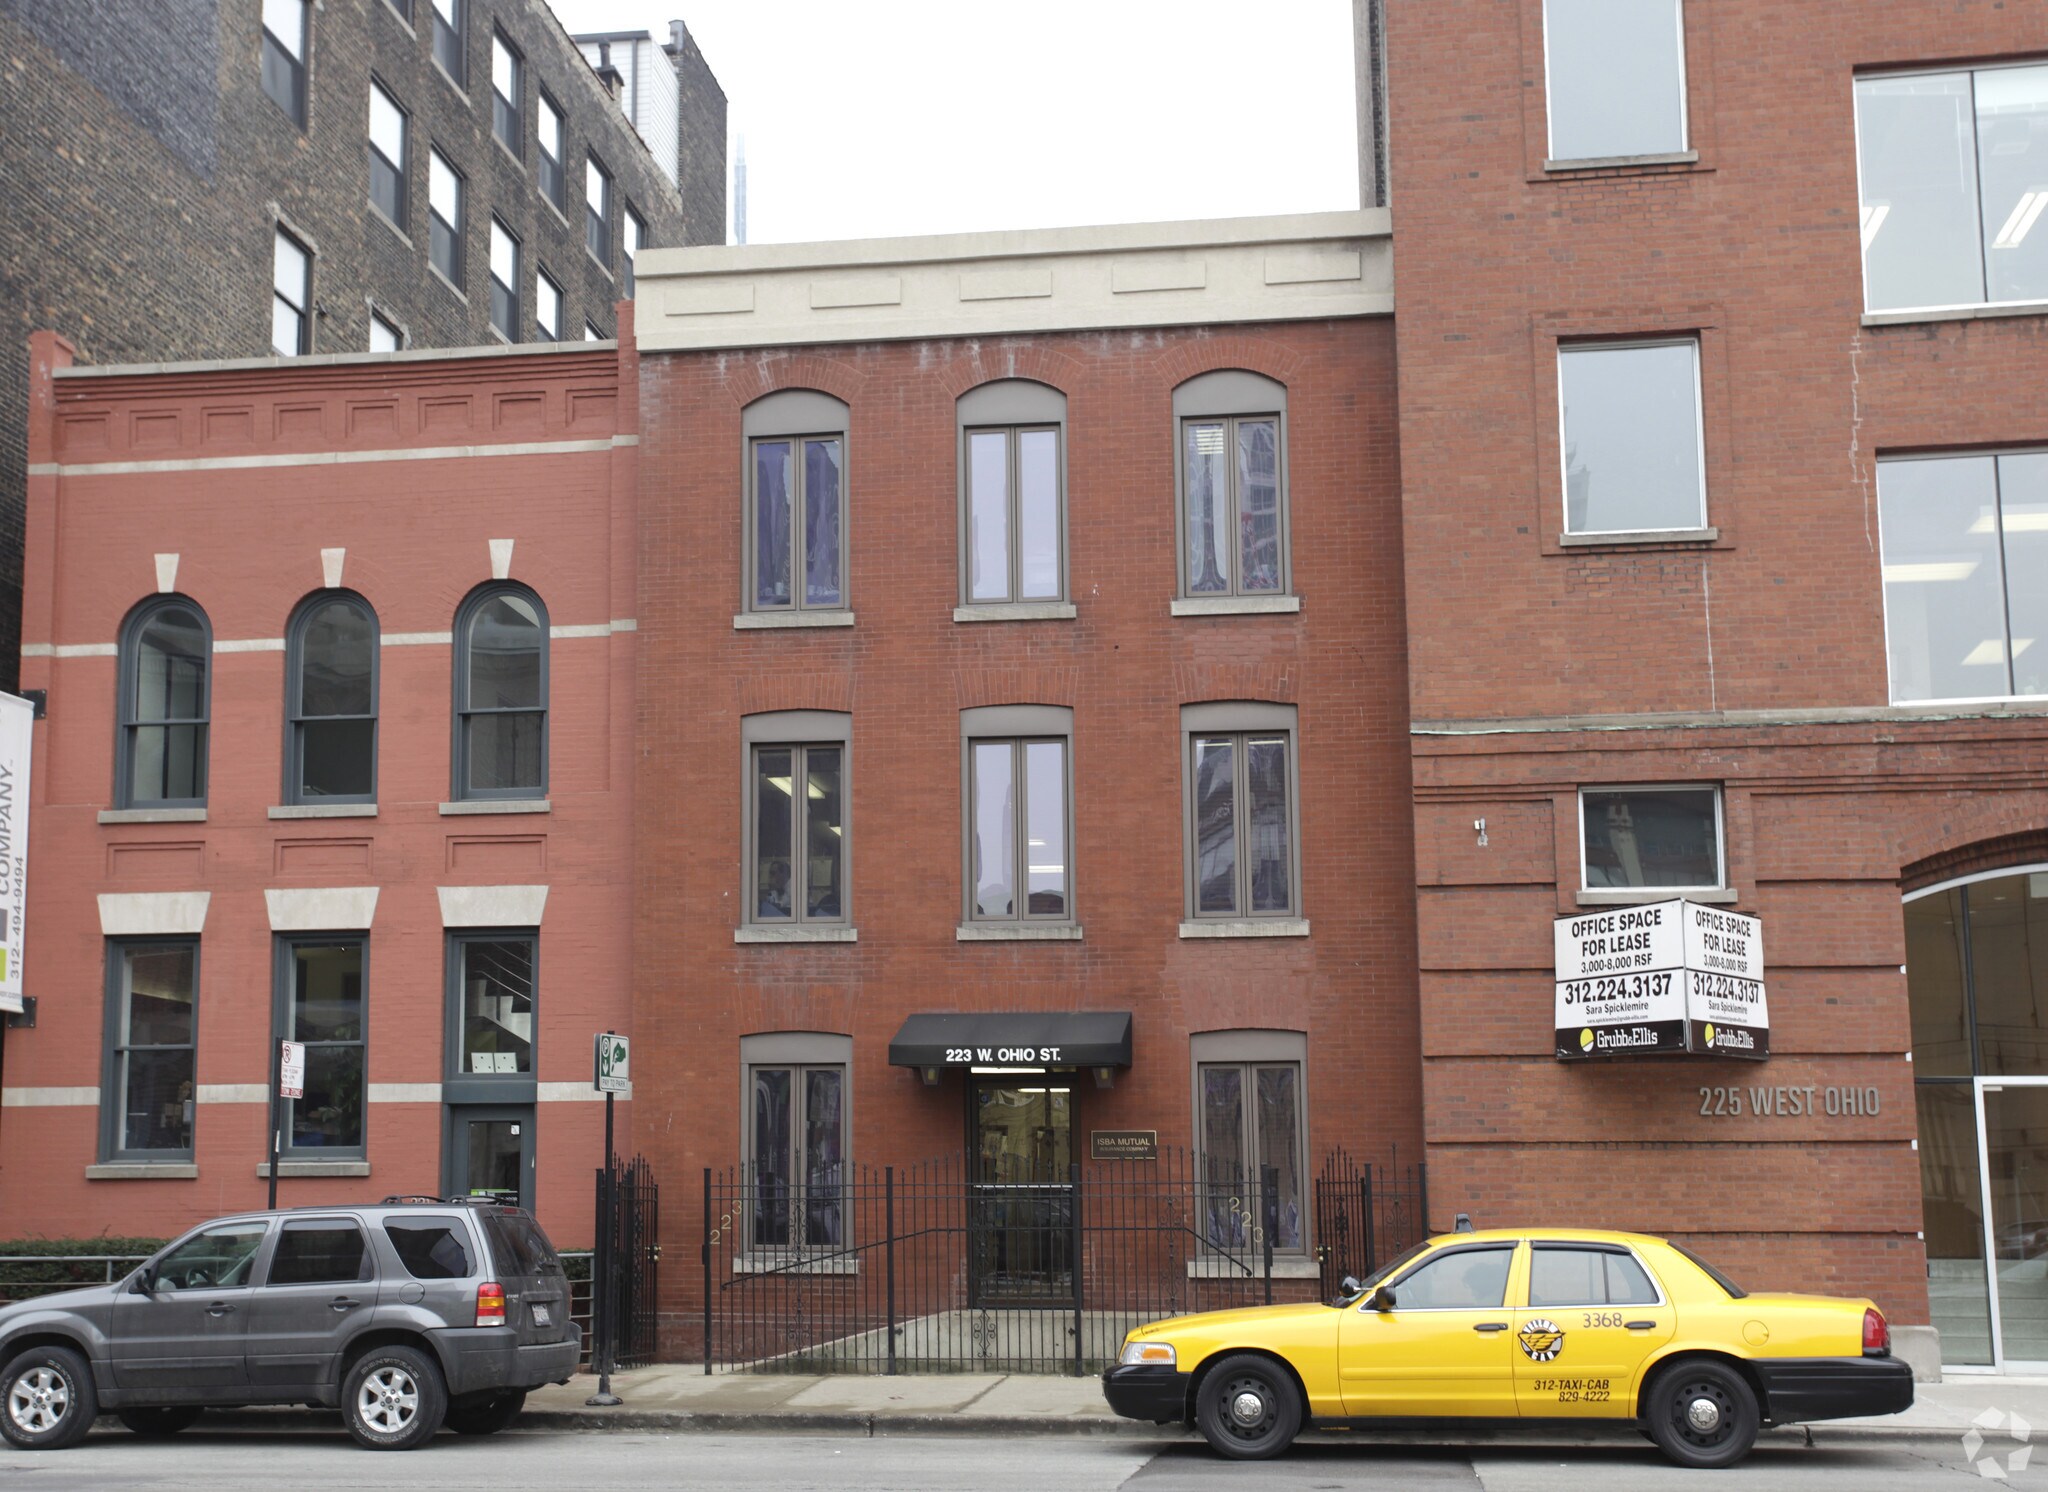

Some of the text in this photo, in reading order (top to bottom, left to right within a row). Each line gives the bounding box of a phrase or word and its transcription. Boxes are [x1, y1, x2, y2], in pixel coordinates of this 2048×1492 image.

[0, 764, 13, 895] COMPANY
[1572, 909, 1662, 938] OFFICE SPACE
[1696, 910, 1751, 937] OFFICE SPACE
[1582, 932, 1651, 957] FOR LEASE
[1703, 933, 1746, 956] FOR LEASE
[1581, 953, 1653, 974] 3,000-8,000 RSF
[1704, 954, 1748, 973] 3,000-8,000 RSF
[1565, 974, 1672, 1004] 312.224.3137
[1693, 972, 1759, 1003] 312.224.3137
[1586, 1001, 1649, 1015] Sara Spicklemire
[1708, 1000, 1720, 1010] Sara
[946, 1047, 1062, 1062] 223 W. OHIO ST.
[1700, 1086, 1881, 1115] 225 WEST OHIO
[1097, 1138, 1151, 1146] ISBA MUTUAL
[710, 1200, 742, 1245] 223
[1229, 1196, 1264, 1243] 223
[1583, 1313, 1623, 1328] 3368
[1534, 1379, 1610, 1391] 312-TAXI-CAB
[1558, 1391, 1610, 1402] 829-4222
